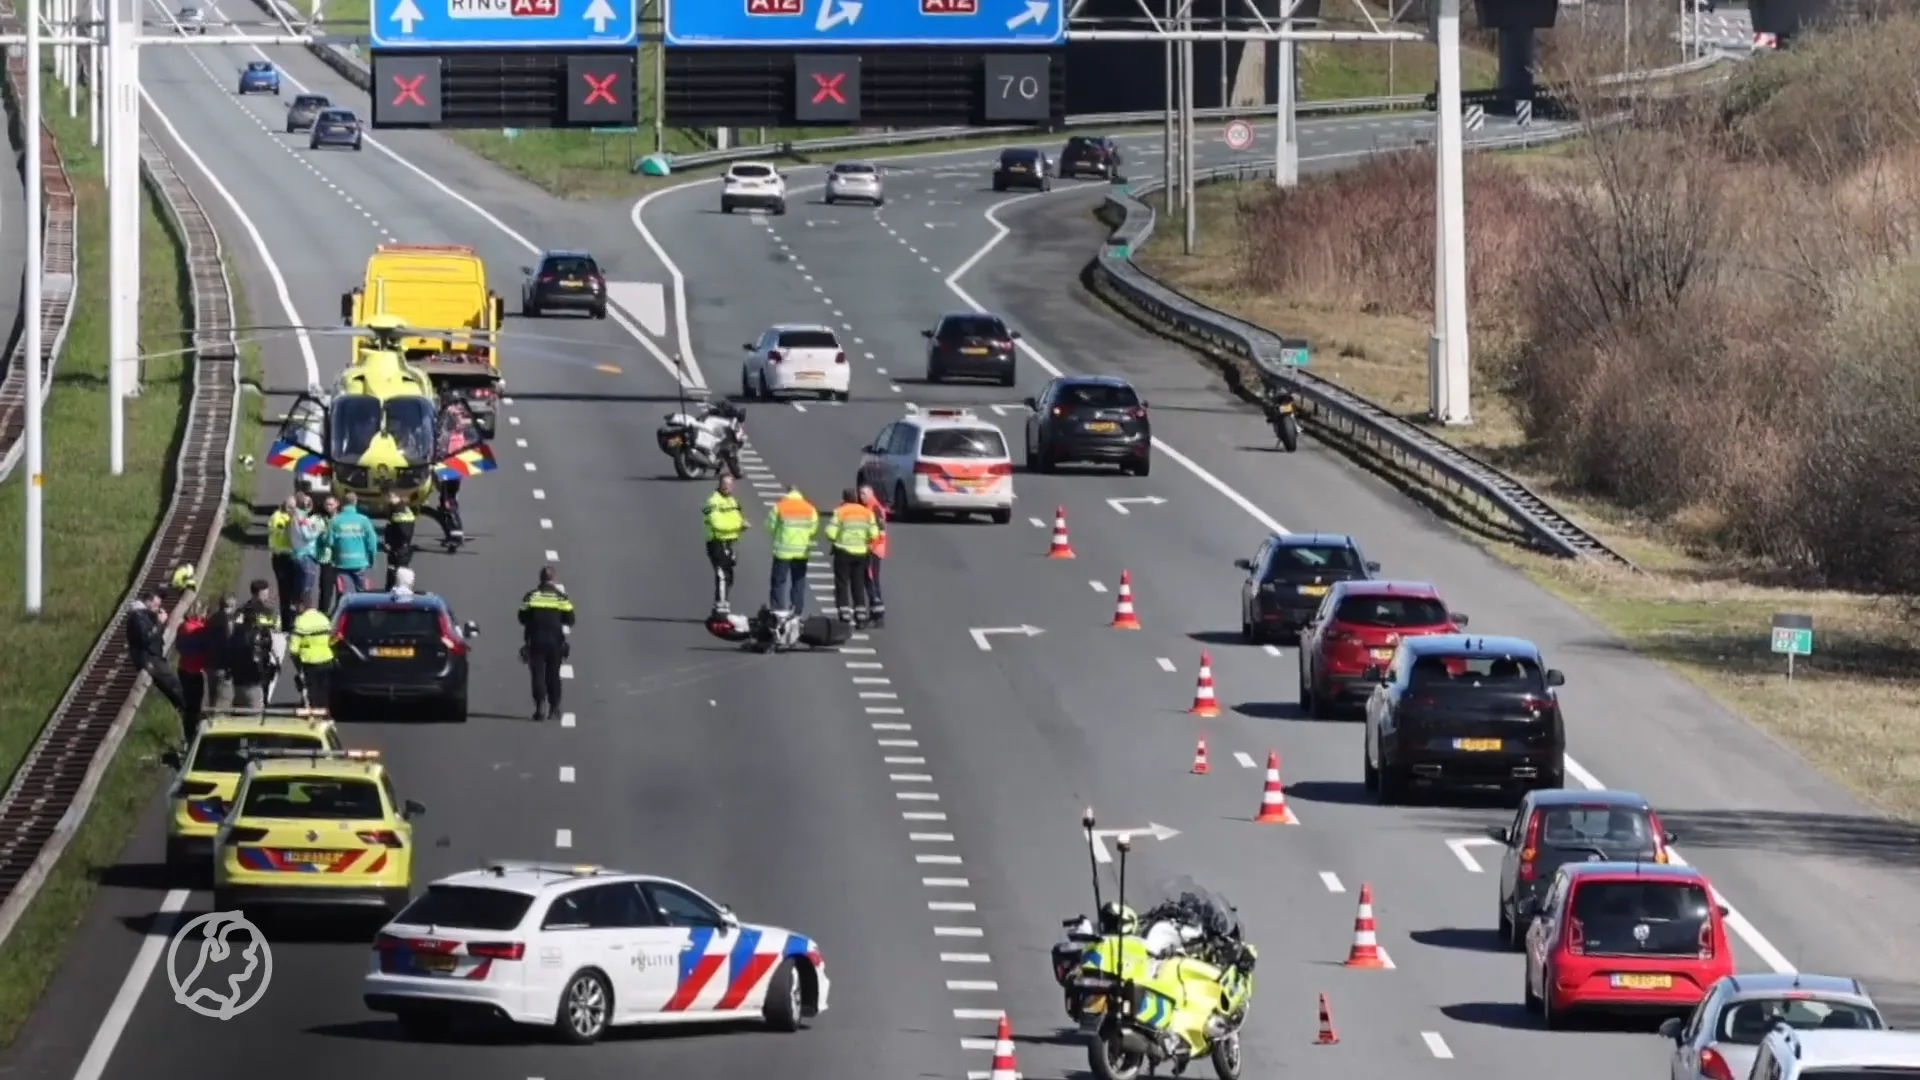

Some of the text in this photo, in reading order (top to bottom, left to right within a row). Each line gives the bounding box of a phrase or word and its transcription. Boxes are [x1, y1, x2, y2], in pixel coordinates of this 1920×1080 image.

[451, 0, 553, 12] RING A4
[996, 74, 1039, 99] 70
[631, 951, 673, 970] POLITIE
